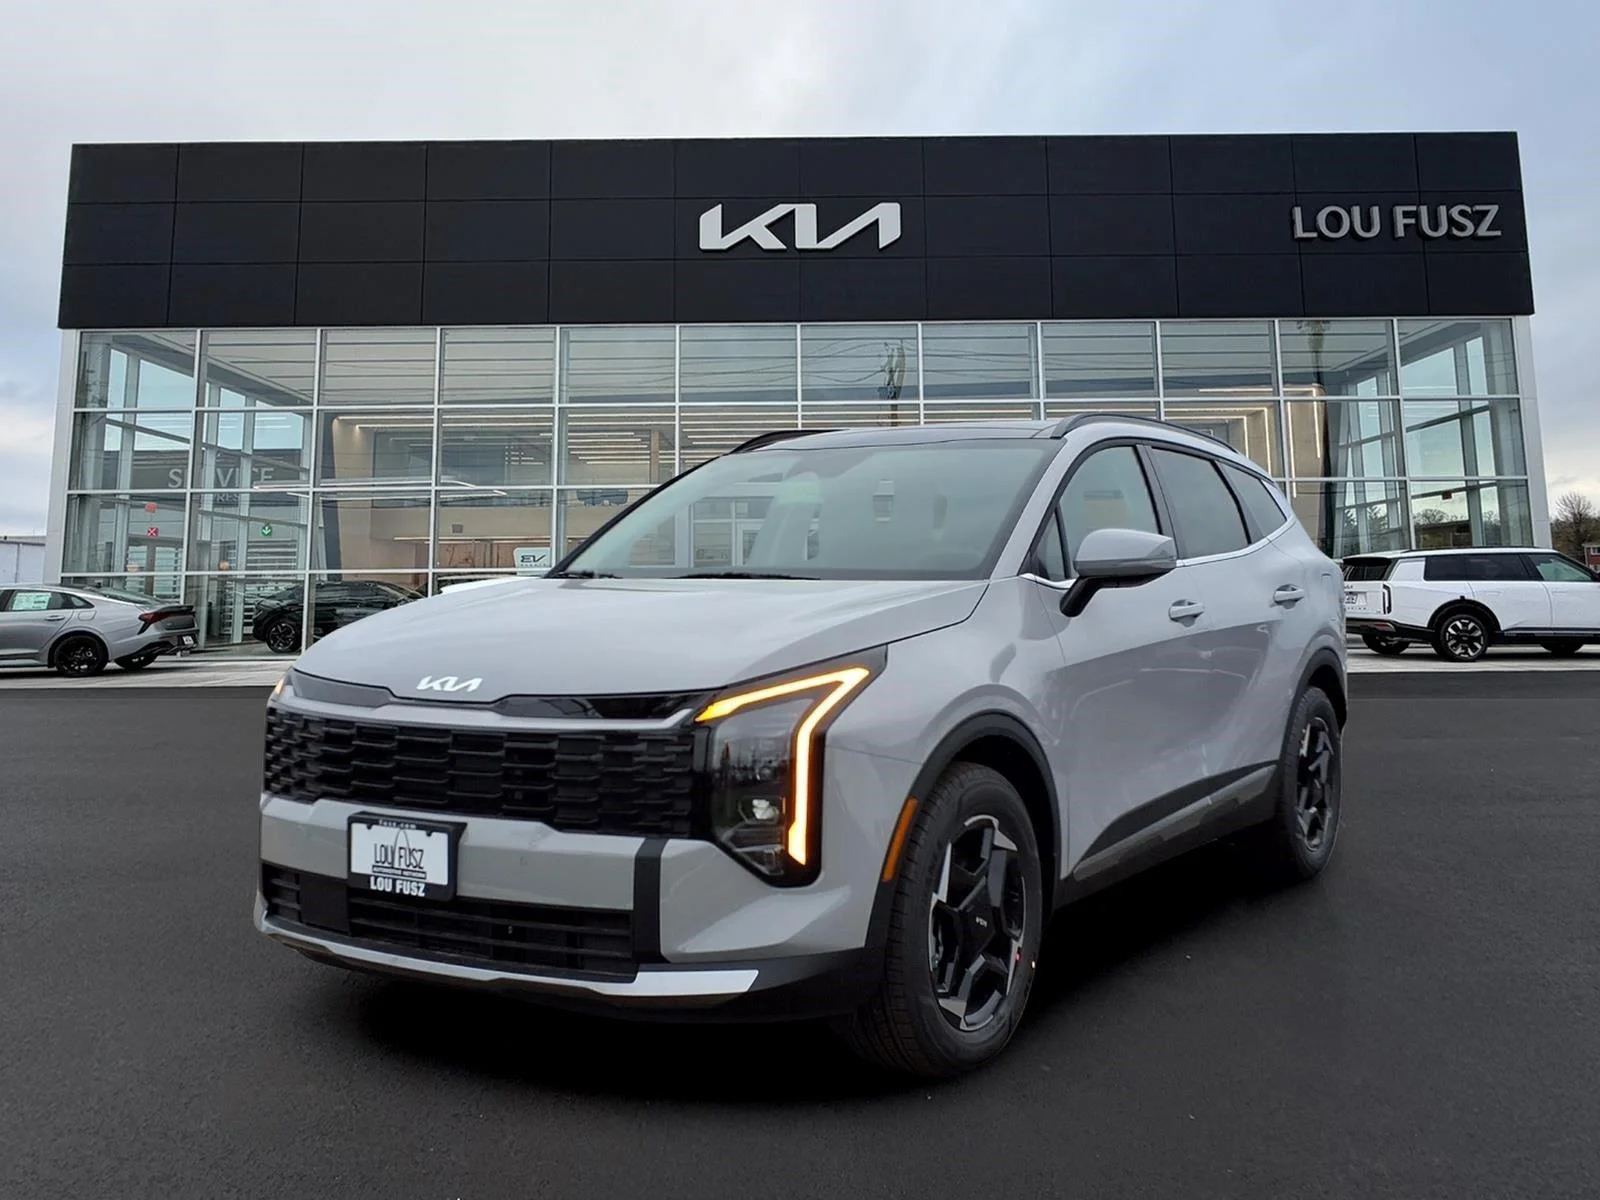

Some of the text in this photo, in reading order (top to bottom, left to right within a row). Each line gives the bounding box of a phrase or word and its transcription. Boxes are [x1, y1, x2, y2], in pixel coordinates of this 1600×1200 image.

[699, 202, 902, 250] KIA
[1292, 204, 1502, 239] LOU FUSZ
[167, 467, 275, 488] SVIE
[416, 675, 483, 692] KIA
[373, 842, 425, 870] LOU FUSZ
[369, 876, 426, 898] LOU FUSZ
